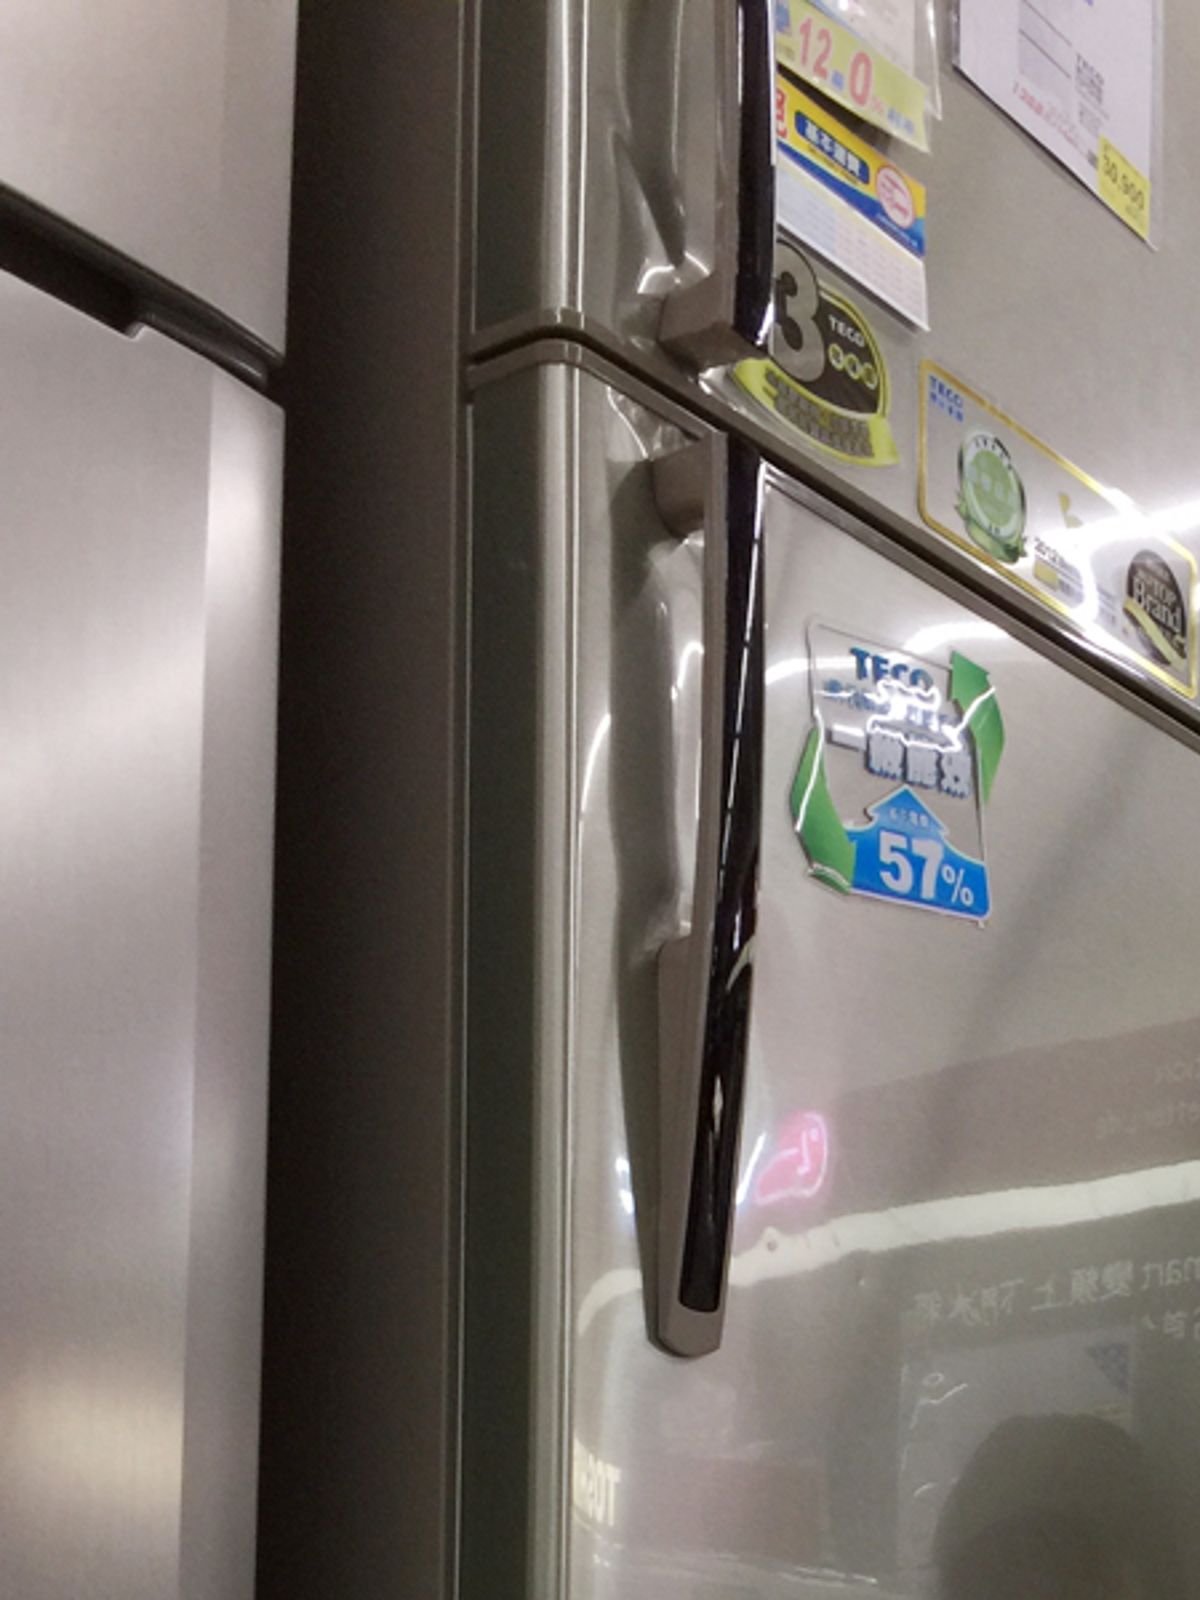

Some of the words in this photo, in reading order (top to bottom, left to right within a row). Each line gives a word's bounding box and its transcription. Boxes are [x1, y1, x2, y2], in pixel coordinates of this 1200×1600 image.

[828, 313, 867, 349] TECO
[928, 374, 965, 410] TECO
[849, 646, 934, 690] TECO
[879, 830, 975, 907] 57%
